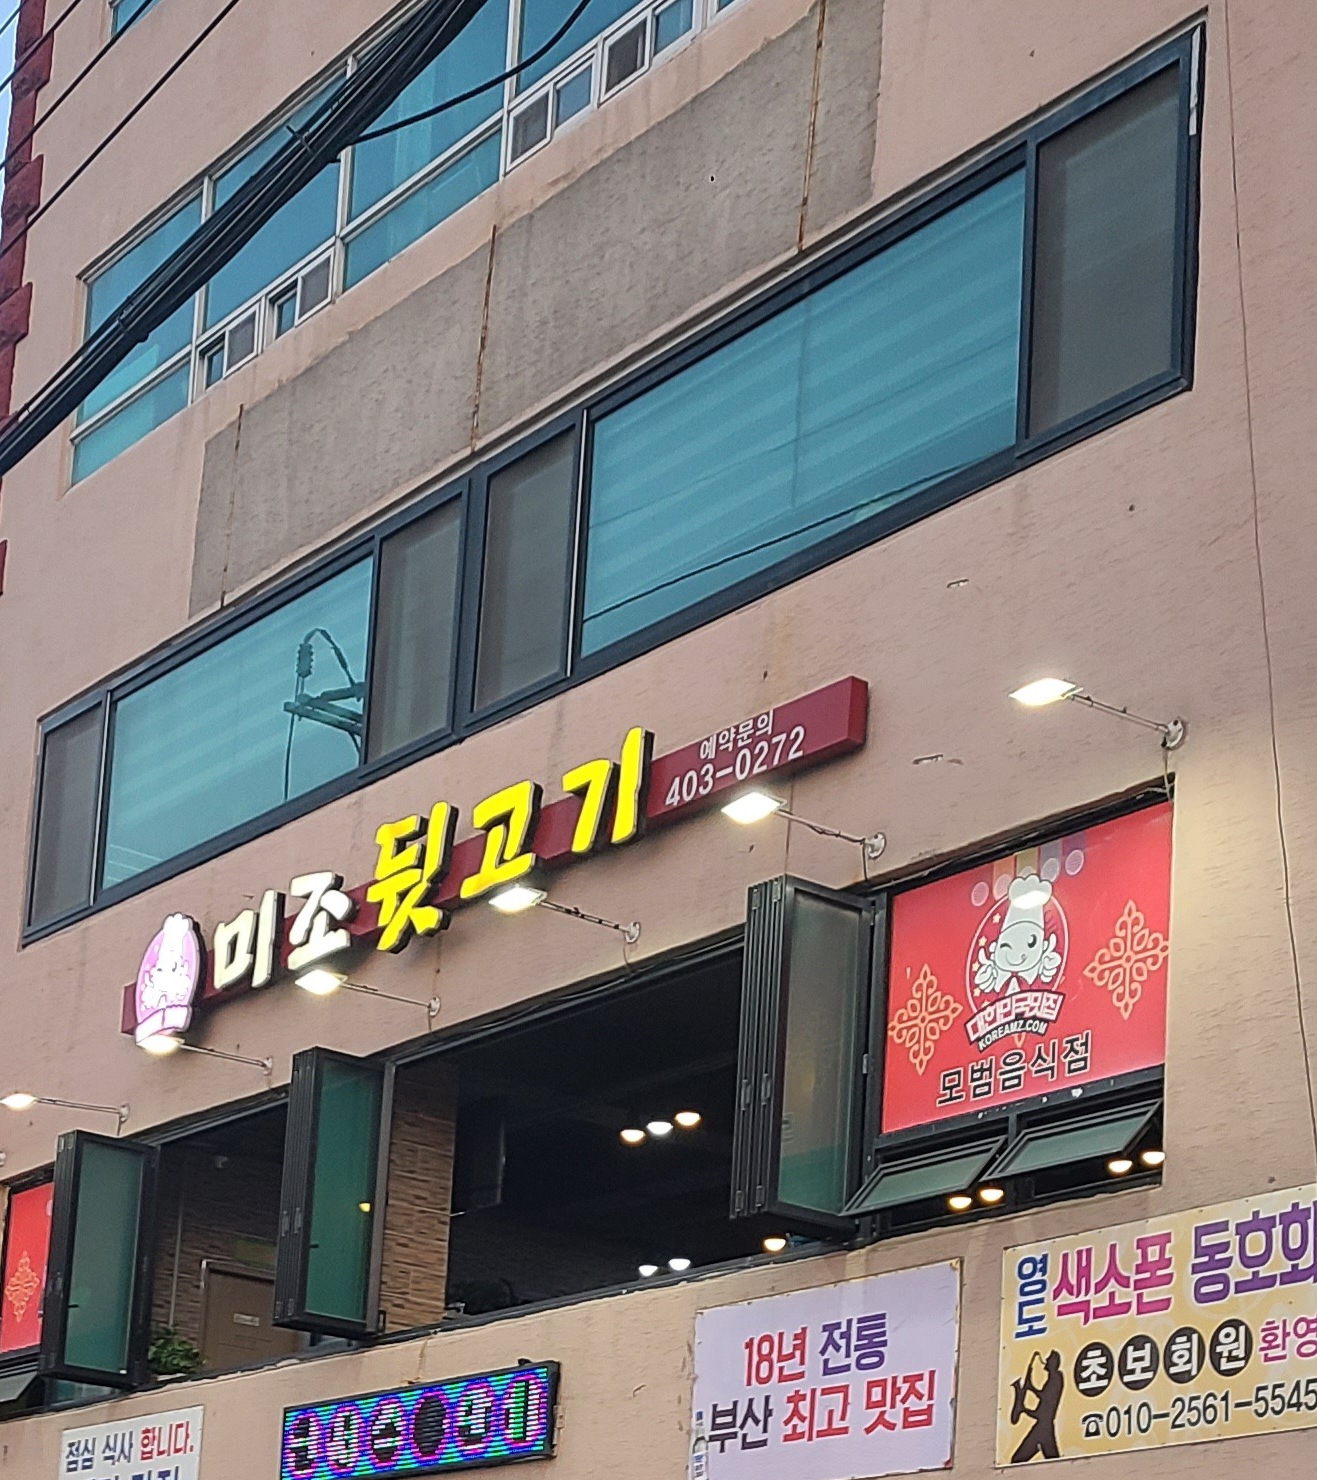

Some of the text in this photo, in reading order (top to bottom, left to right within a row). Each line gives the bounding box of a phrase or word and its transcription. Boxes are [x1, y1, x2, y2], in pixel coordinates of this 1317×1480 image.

[664, 725, 806, 807] 403-0272
[700, 708, 774, 760] 예약문의
[212, 726, 654, 991] 미조 뒷고기
[936, 1030, 1092, 1107] 모범음식점
[1053, 1230, 1174, 1326] 색소폰
[744, 1312, 890, 1387] 18년 전통
[65, 1421, 194, 1473] 점심 식사 합니다.
[708, 1369, 936, 1454] 부산 최고 맛집
